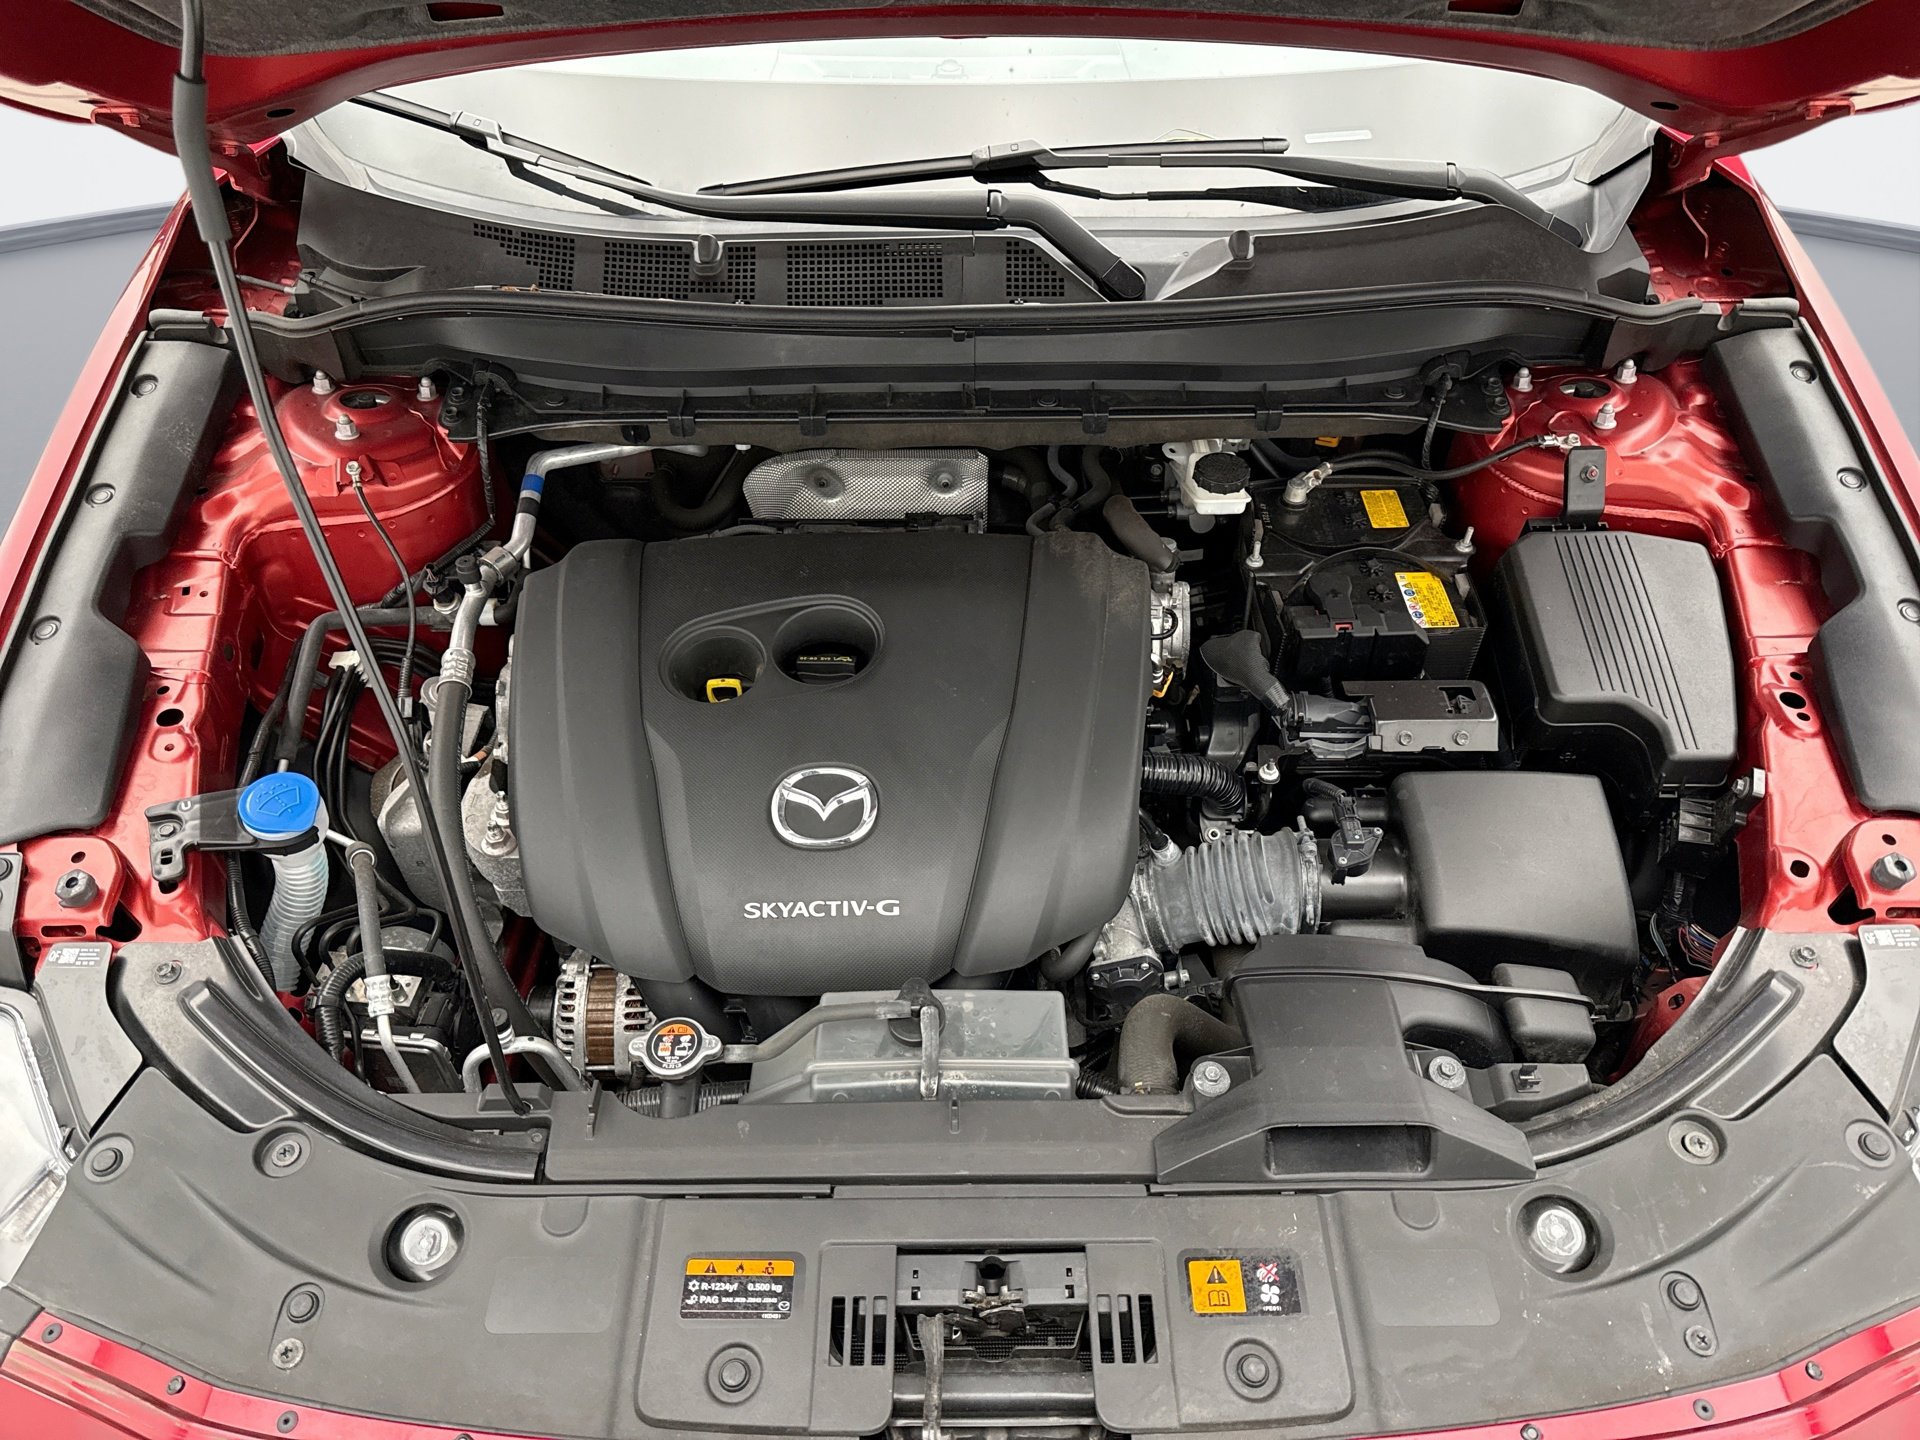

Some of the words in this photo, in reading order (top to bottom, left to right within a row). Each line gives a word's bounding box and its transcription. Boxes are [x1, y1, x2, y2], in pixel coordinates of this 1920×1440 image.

[743, 899, 900, 919] SKYACTIV-G
[700, 1282, 739, 1292] R-1234yf
[747, 1283, 770, 1291] 0.500
[771, 1283, 783, 1293] kg
[699, 1295, 719, 1304] PAG
